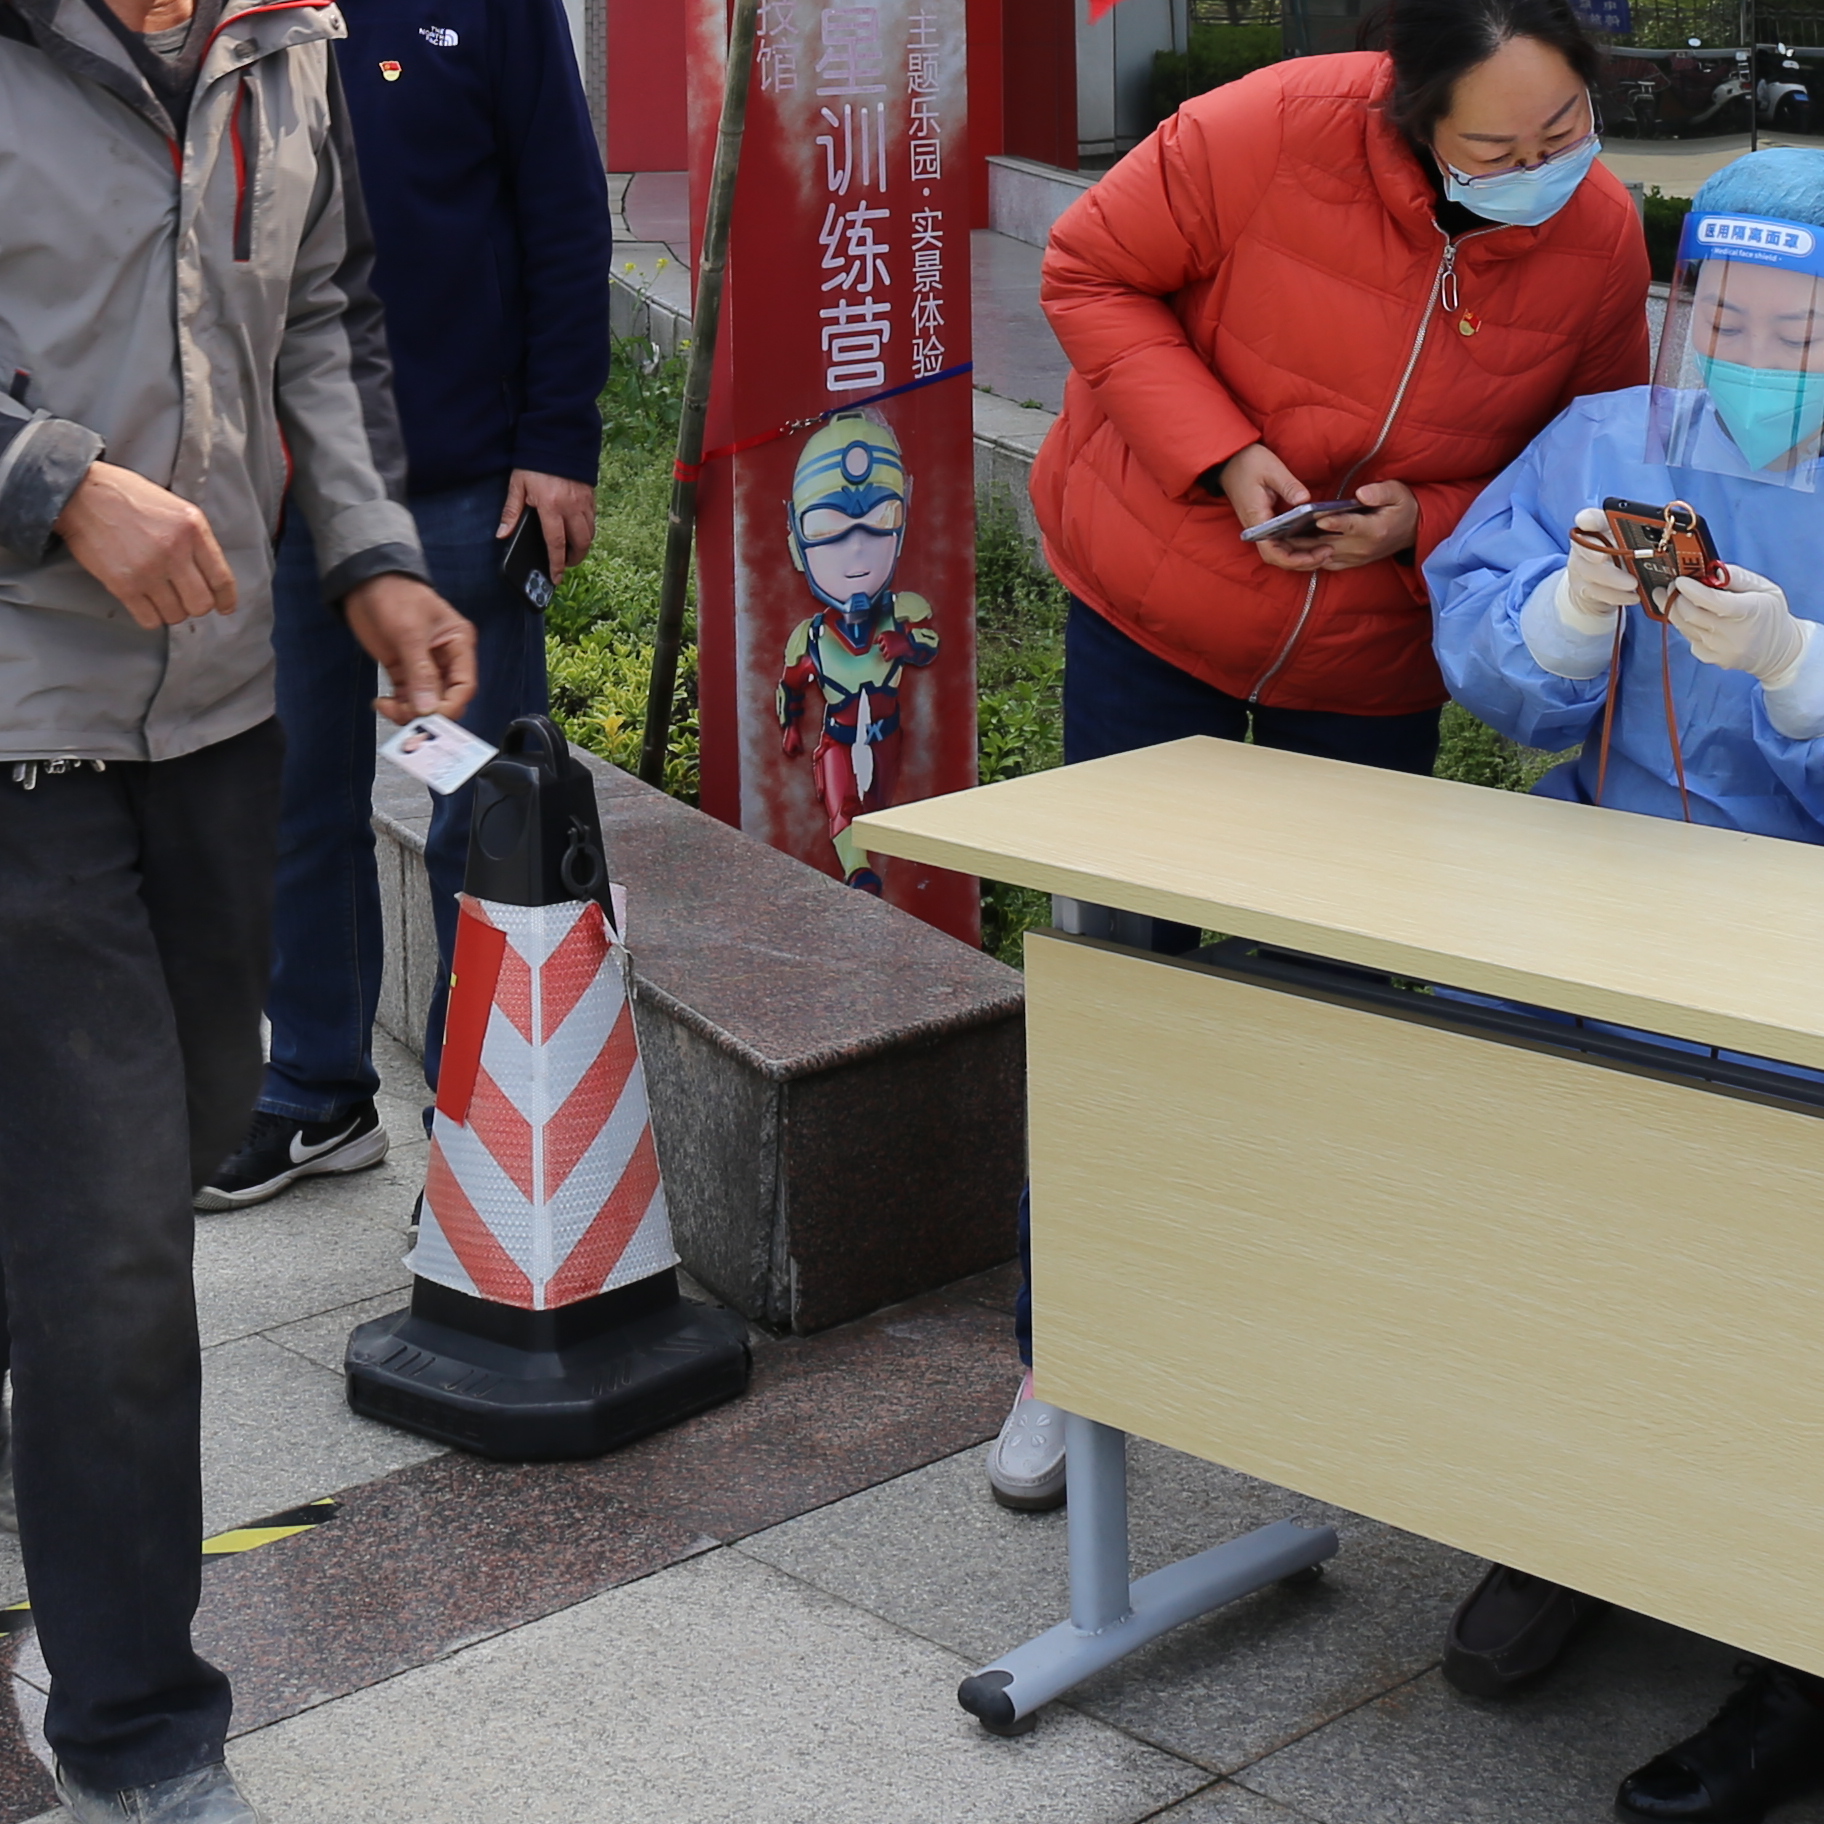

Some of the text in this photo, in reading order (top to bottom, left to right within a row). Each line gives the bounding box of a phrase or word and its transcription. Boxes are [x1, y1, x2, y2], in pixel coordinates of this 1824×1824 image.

[1704, 222, 1799, 250] 医用隔离面罩
